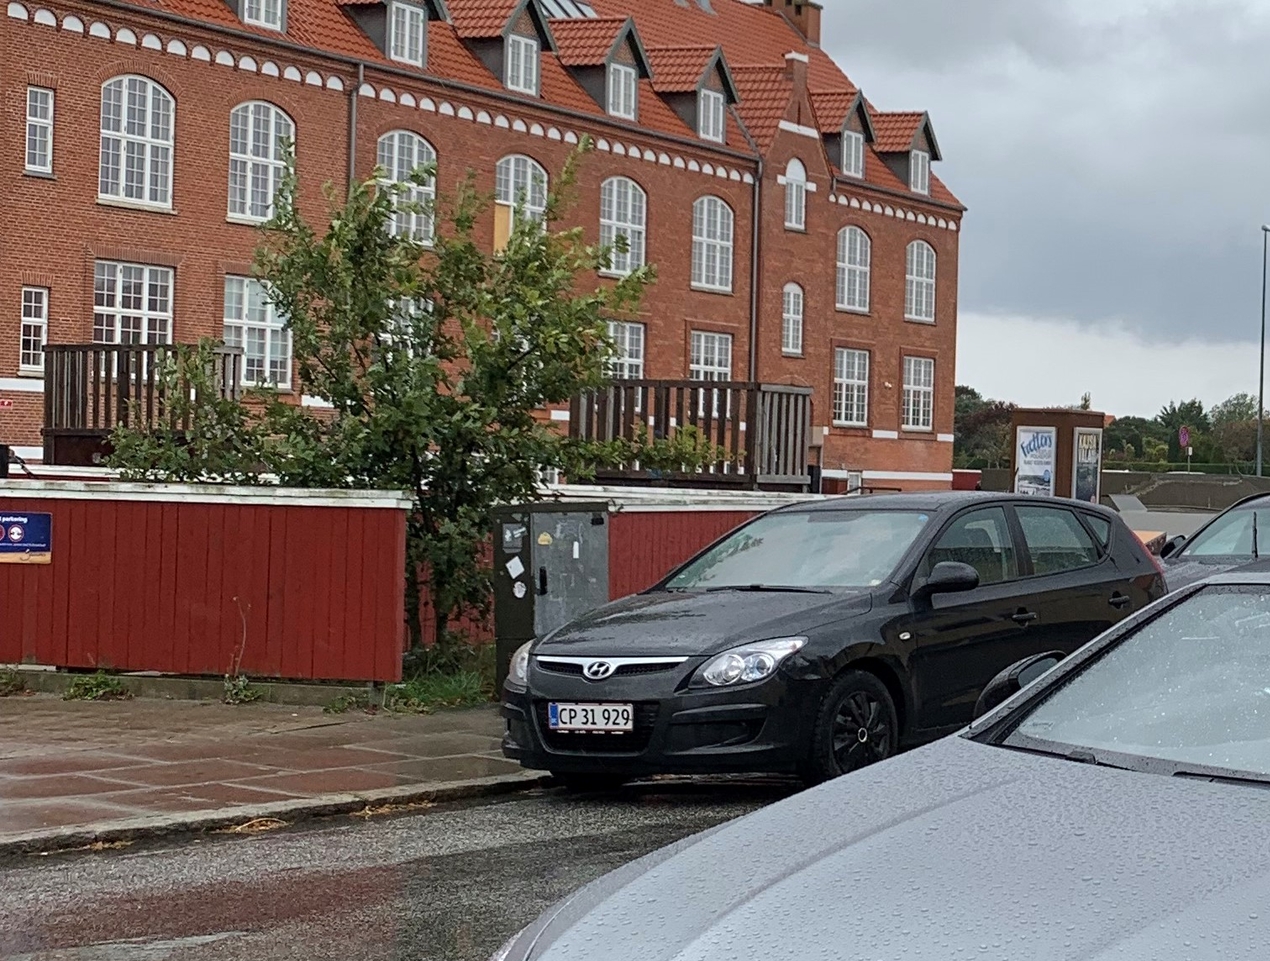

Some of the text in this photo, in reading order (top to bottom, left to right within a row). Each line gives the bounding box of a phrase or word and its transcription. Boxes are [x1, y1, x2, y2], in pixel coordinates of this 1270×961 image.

[559, 708, 577, 725] CP
[581, 708, 597, 725] 31
[602, 708, 630, 726] 929
